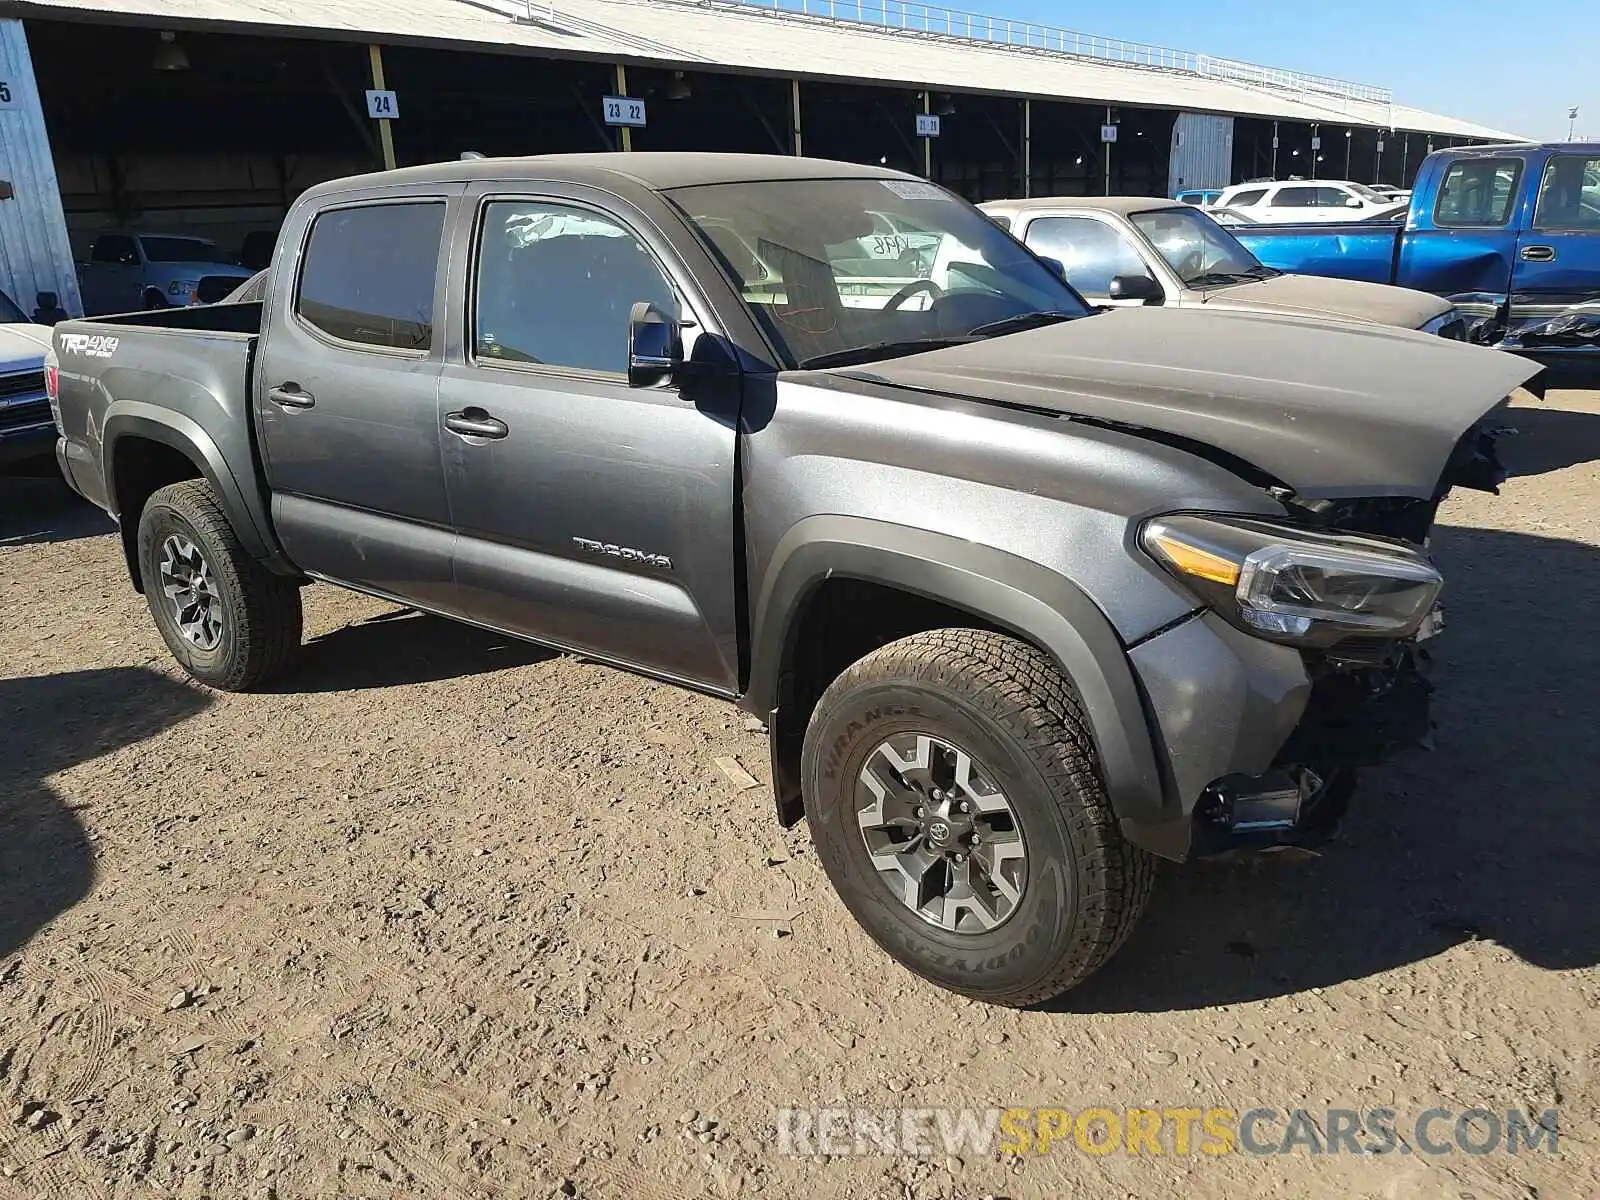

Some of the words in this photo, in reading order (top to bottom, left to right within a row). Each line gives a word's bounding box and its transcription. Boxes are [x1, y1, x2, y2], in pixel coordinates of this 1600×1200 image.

[374, 95, 391, 113] 24
[608, 103, 621, 118] 23
[629, 104, 641, 119] 22
[572, 536, 673, 570] TACOMA
